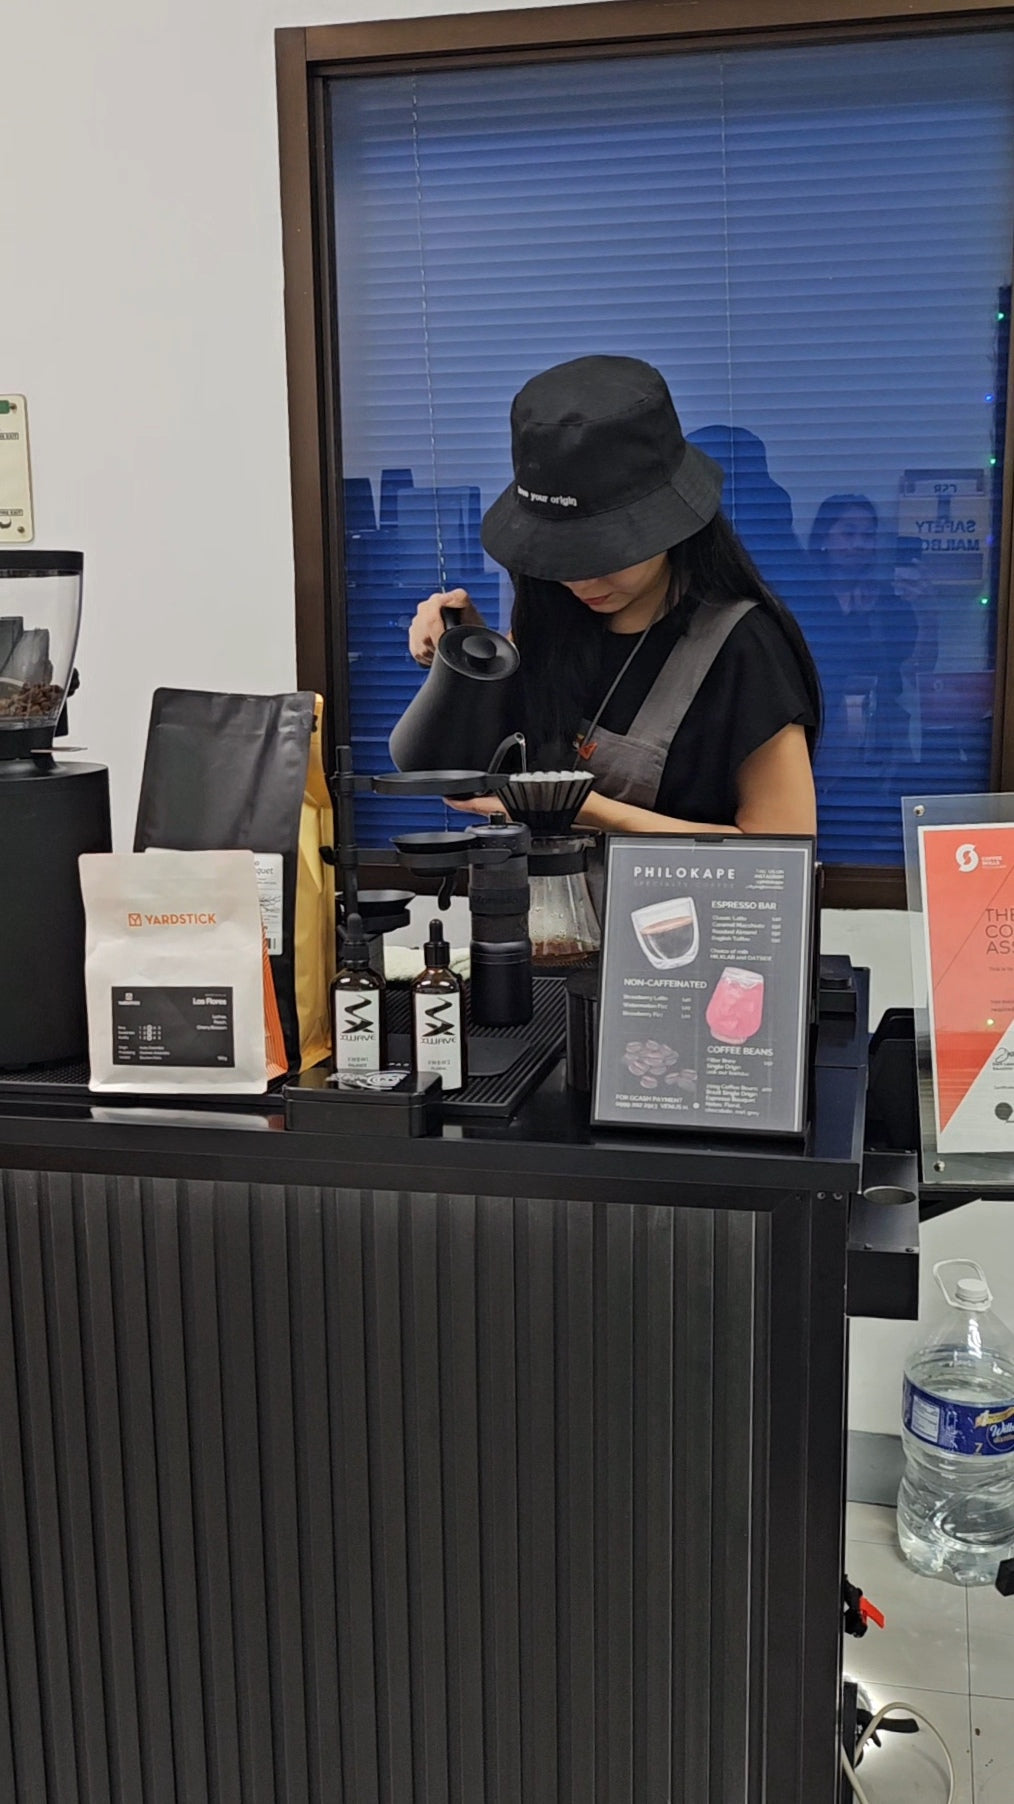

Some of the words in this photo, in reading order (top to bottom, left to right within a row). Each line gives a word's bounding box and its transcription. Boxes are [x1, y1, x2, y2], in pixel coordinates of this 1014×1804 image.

[530, 492, 548, 503] your
[550, 495, 577, 507] origin
[633, 866, 736, 880] PHILOKAPE
[711, 900, 757, 910] ESPRESSO
[758, 902, 777, 911] BAR
[144, 912, 217, 926] YARDSTICK
[623, 978, 708, 989] NON-CAFFEINATED
[192, 997, 206, 1005] Los
[205, 997, 227, 1005] Flores
[707, 1045, 741, 1055] COFFEE
[742, 1047, 774, 1057] BEANS
[974, 1442, 983, 1453] 7
